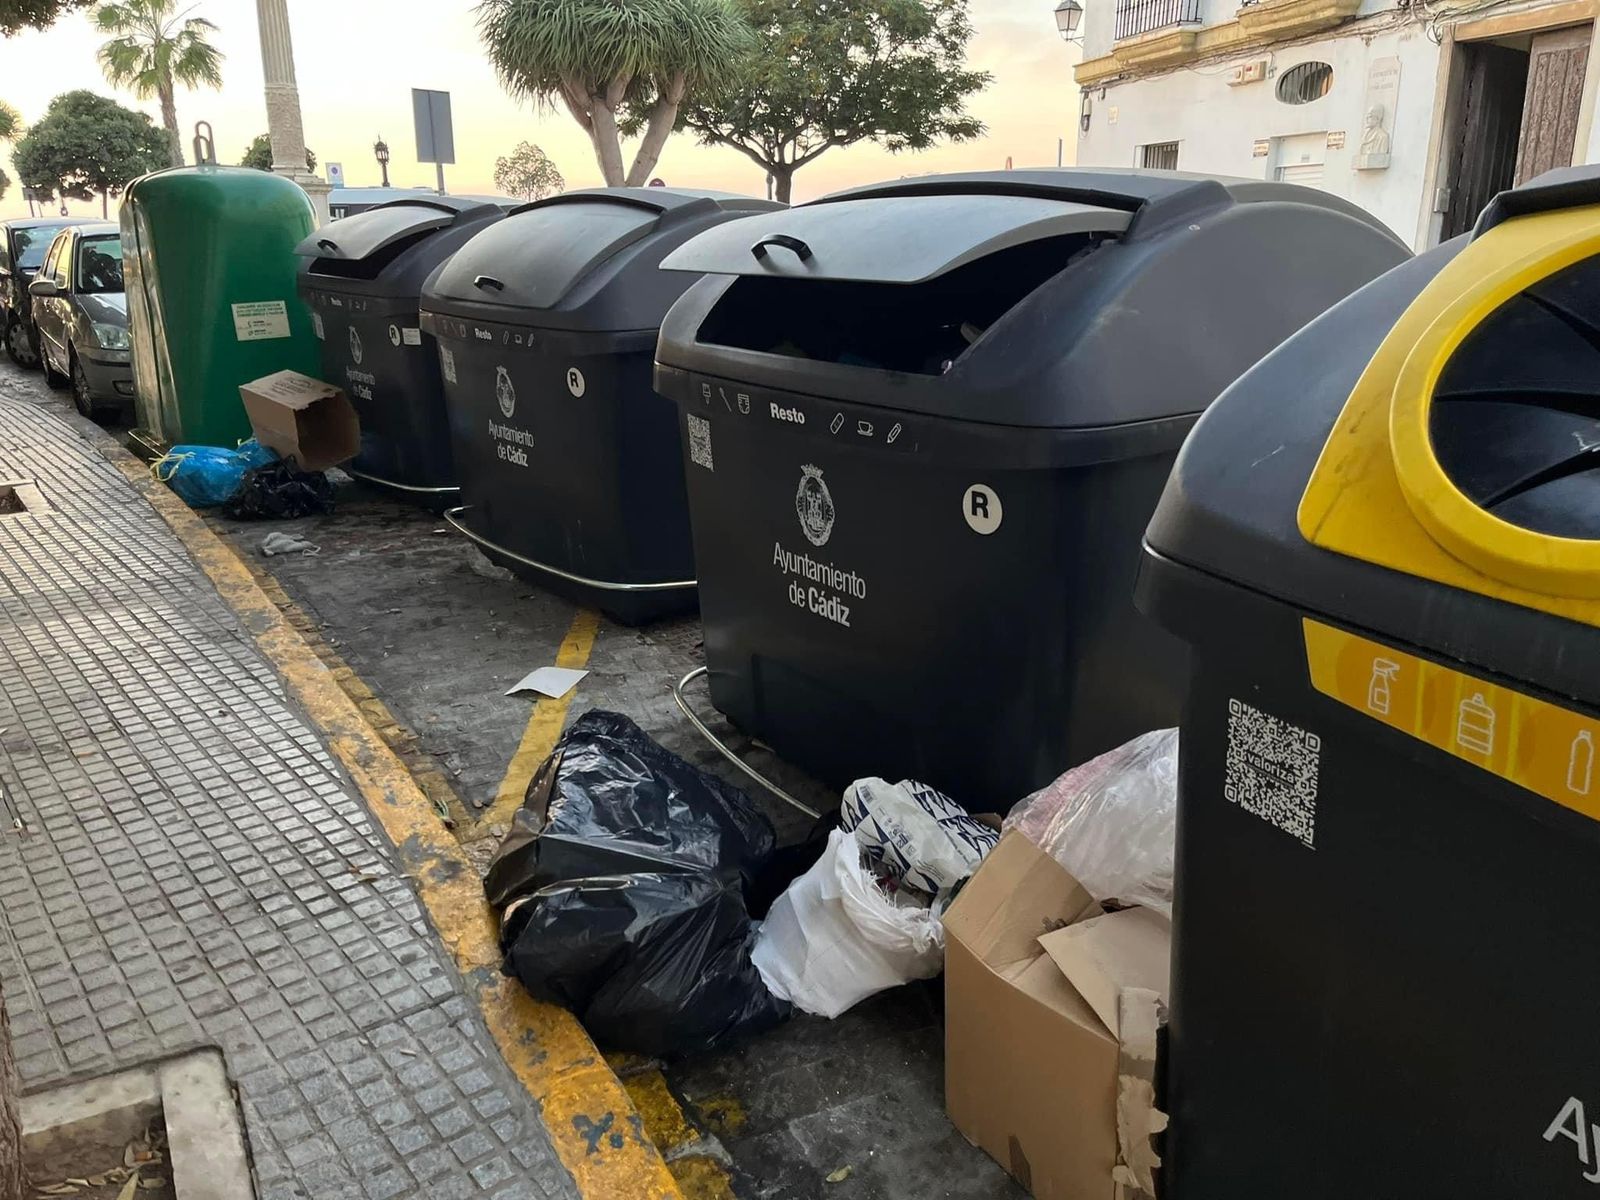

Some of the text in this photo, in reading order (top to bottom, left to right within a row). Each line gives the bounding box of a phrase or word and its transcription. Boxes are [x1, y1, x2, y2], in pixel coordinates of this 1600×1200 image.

[391, 328, 397, 340] R
[475, 328, 492, 341] Resto
[569, 371, 579, 388] R
[769, 402, 806, 425] Resto
[488, 419, 535, 448] Ayuntamiento
[497, 443, 529, 467] de Cádiz
[971, 490, 990, 520] R
[773, 541, 866, 600] Ayuntamiento
[788, 580, 851, 628] de Cádiz
[1246, 752, 1296, 785] valoriza
